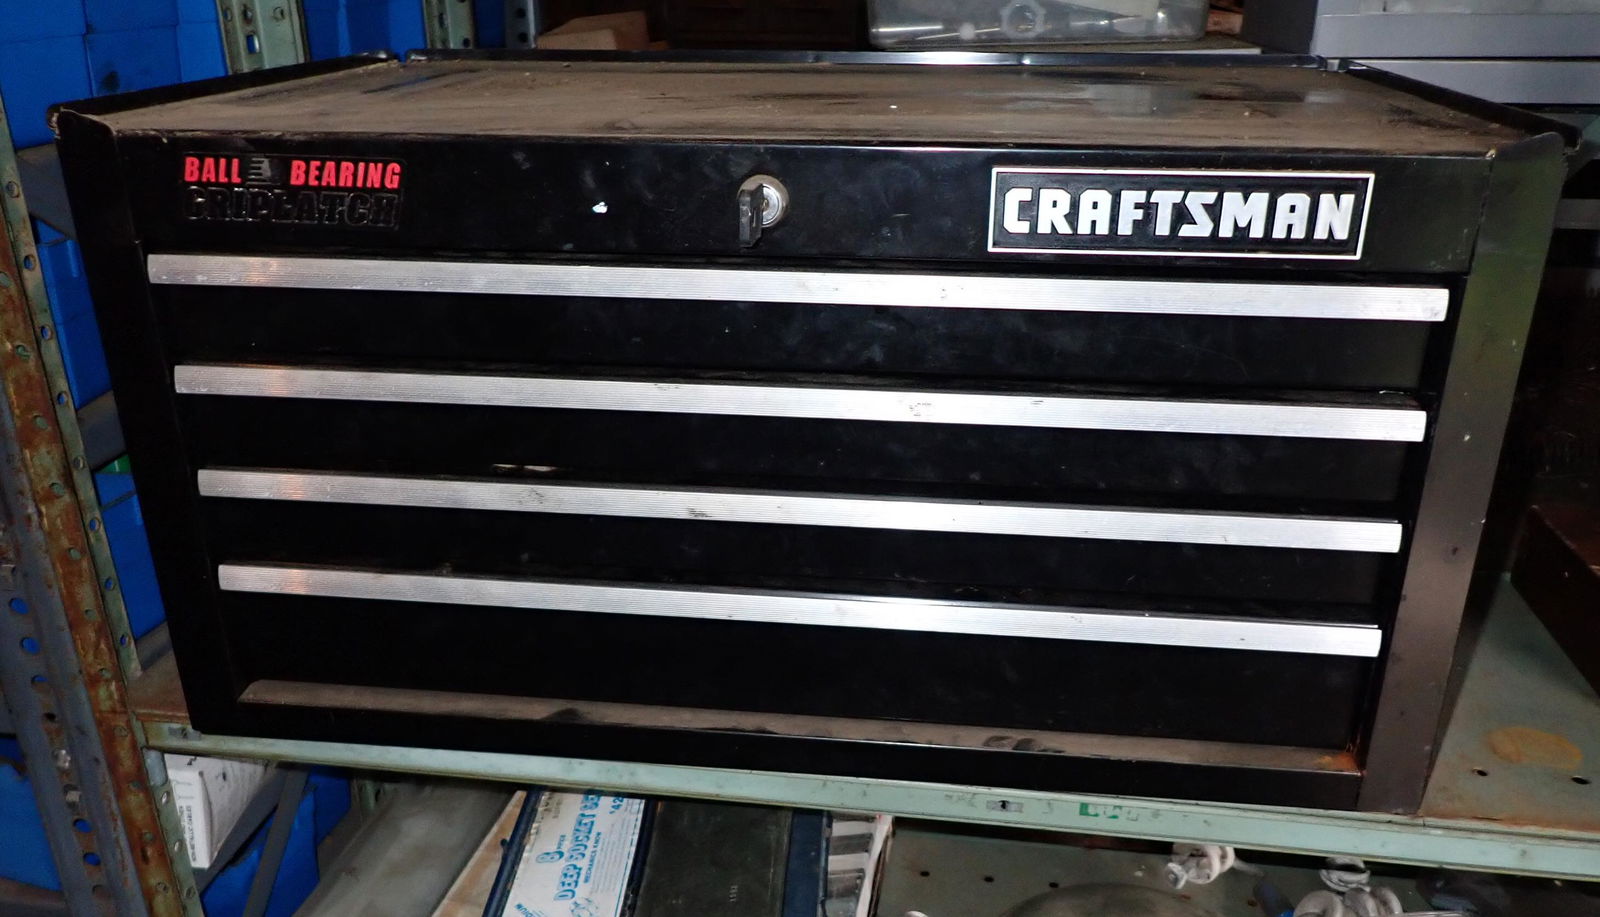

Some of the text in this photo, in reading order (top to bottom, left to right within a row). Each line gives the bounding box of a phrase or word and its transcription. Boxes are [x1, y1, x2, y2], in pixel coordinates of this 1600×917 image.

[184, 156, 401, 189] BALL BEARING
[185, 185, 400, 227] GRIPLATCH
[1003, 186, 1356, 240] CRAFTSMAN
[536, 850, 565, 863] 8
[565, 813, 597, 862] SOCKET
[553, 863, 582, 901] DEEP
